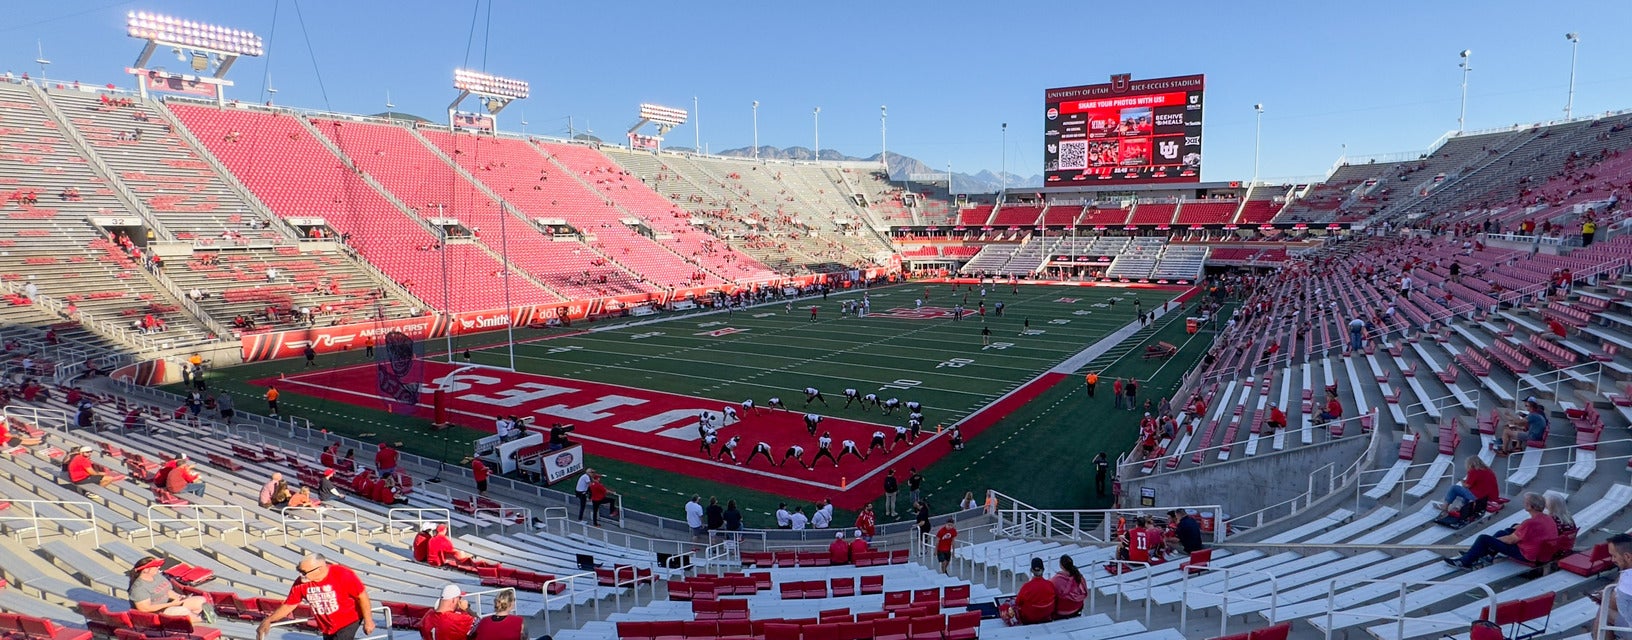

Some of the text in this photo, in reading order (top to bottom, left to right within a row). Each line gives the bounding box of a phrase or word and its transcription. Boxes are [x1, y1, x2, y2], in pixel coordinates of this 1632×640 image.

[1131, 79, 1201, 91] RICE-ECCLES STADIUM
[1078, 101, 1097, 109] SHARE
[1113, 98, 1137, 107] PHOTOS
[1137, 97, 1153, 105] WITH
[539, 305, 582, 319] doTERA
[359, 326, 402, 338] AMERICA
[403, 323, 429, 332] FIRST
[878, 379, 923, 391] 10
